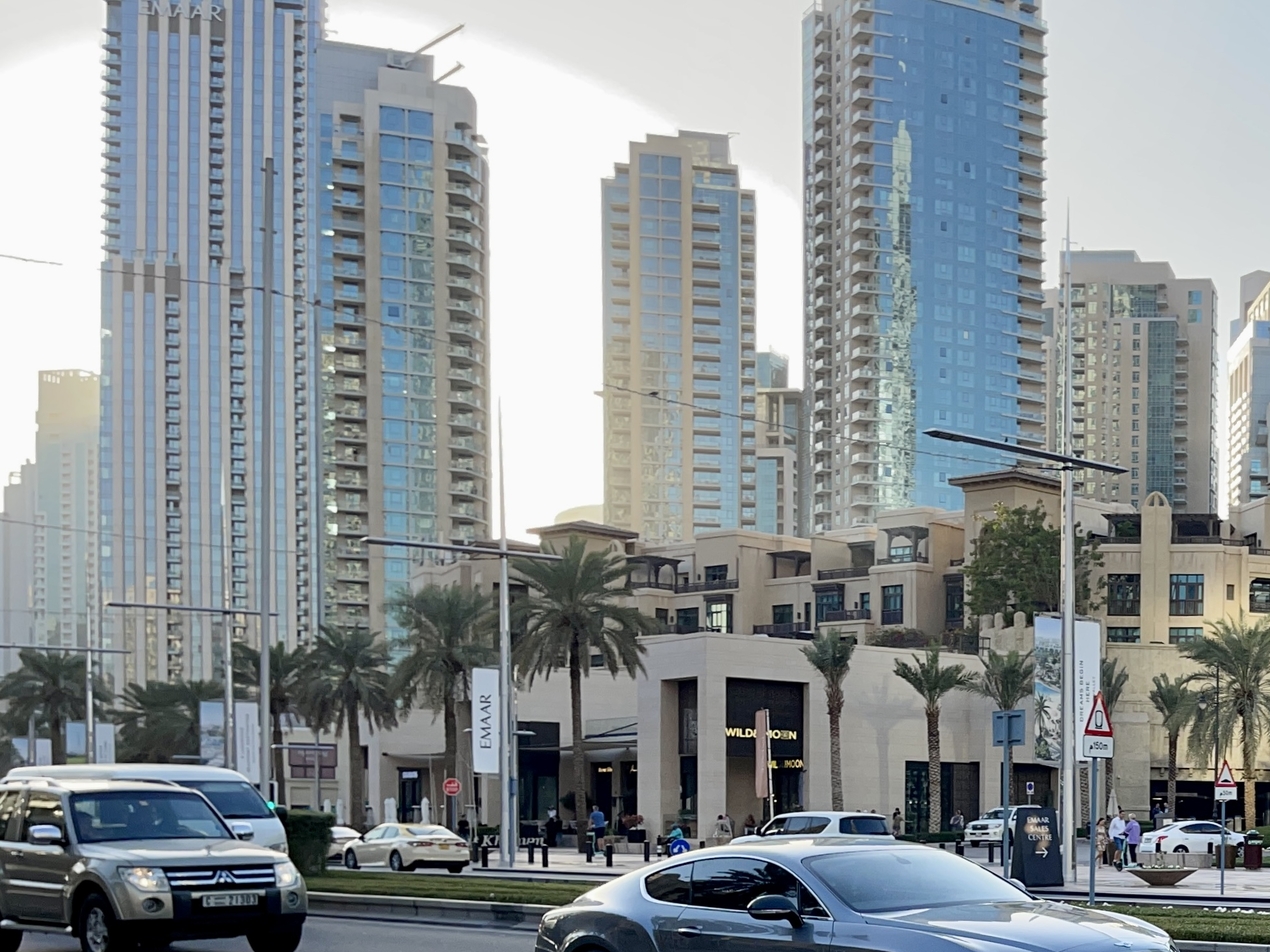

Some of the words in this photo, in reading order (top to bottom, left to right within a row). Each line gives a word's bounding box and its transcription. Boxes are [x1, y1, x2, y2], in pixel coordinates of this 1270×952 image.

[138, 0, 223, 22] EMAAR
[480, 694, 491, 749] EMAAR
[1027, 816, 1050, 824] EMAAR
[1028, 833, 1053, 841] CENTRE
